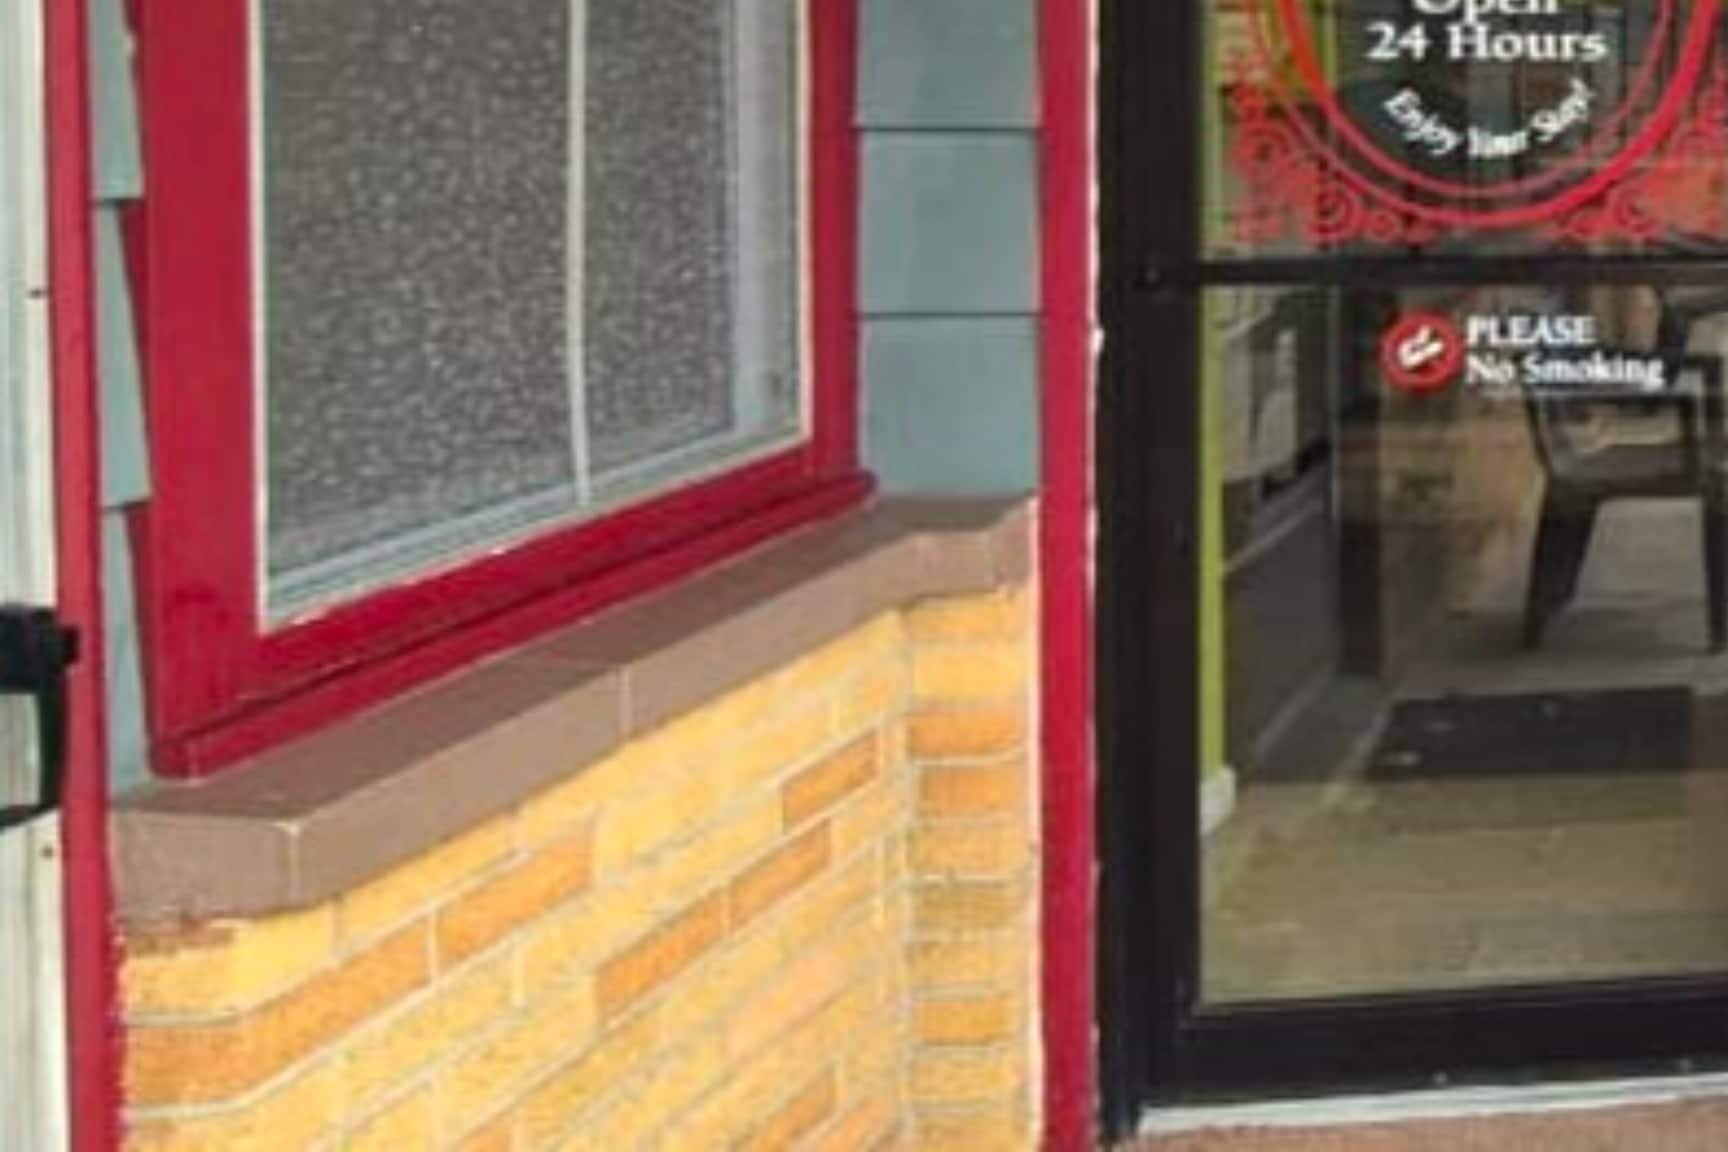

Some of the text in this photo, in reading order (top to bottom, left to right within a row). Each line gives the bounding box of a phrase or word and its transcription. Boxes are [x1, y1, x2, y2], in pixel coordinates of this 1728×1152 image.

[1366, 21, 1608, 61] 24 Hours
[1383, 87, 1462, 156] Enjoy
[1467, 315, 1597, 344] PLEASE
[1467, 350, 1664, 391] No Smoking
